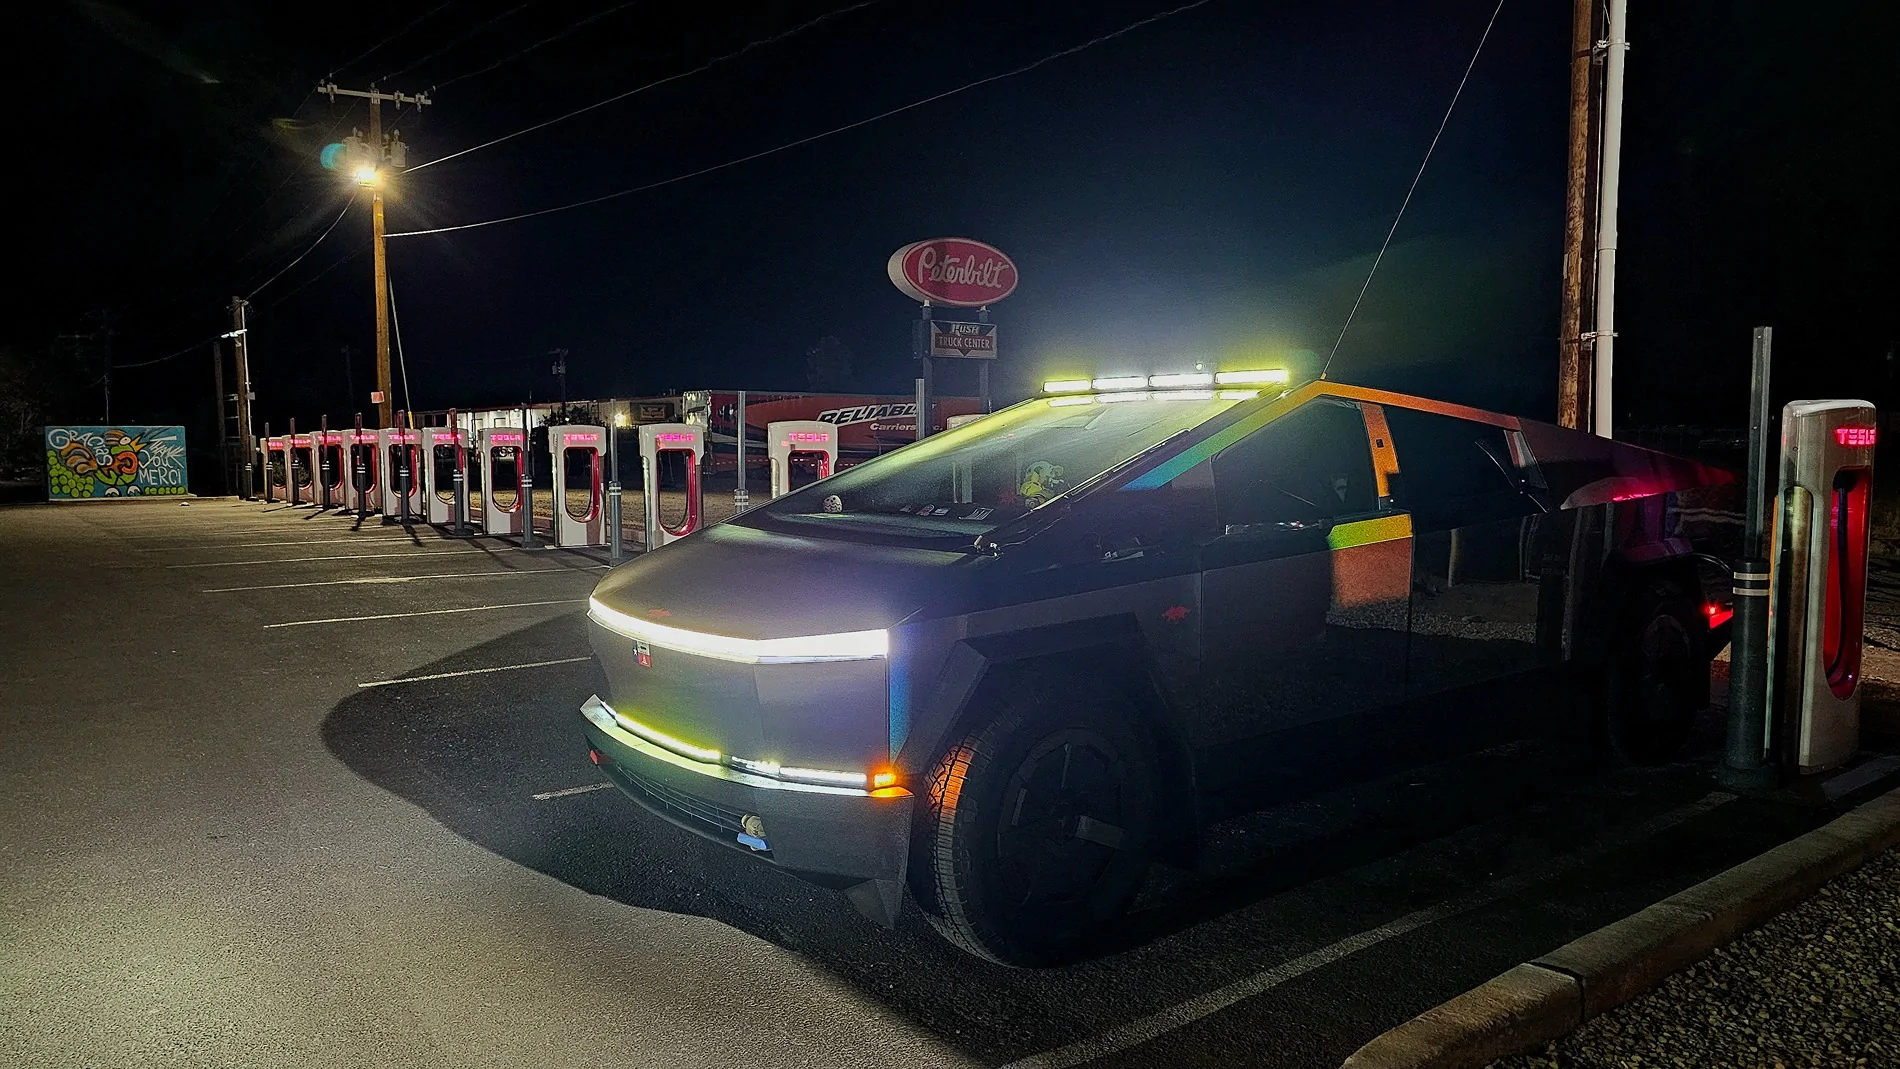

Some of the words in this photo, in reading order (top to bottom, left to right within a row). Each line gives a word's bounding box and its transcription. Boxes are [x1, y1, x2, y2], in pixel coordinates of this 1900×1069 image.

[917, 247, 1010, 289] Peterbilt
[938, 336, 963, 347] TRUCK
[964, 337, 990, 349] CENTER
[816, 402, 937, 427] RELIABL
[788, 432, 829, 442] TESLA
